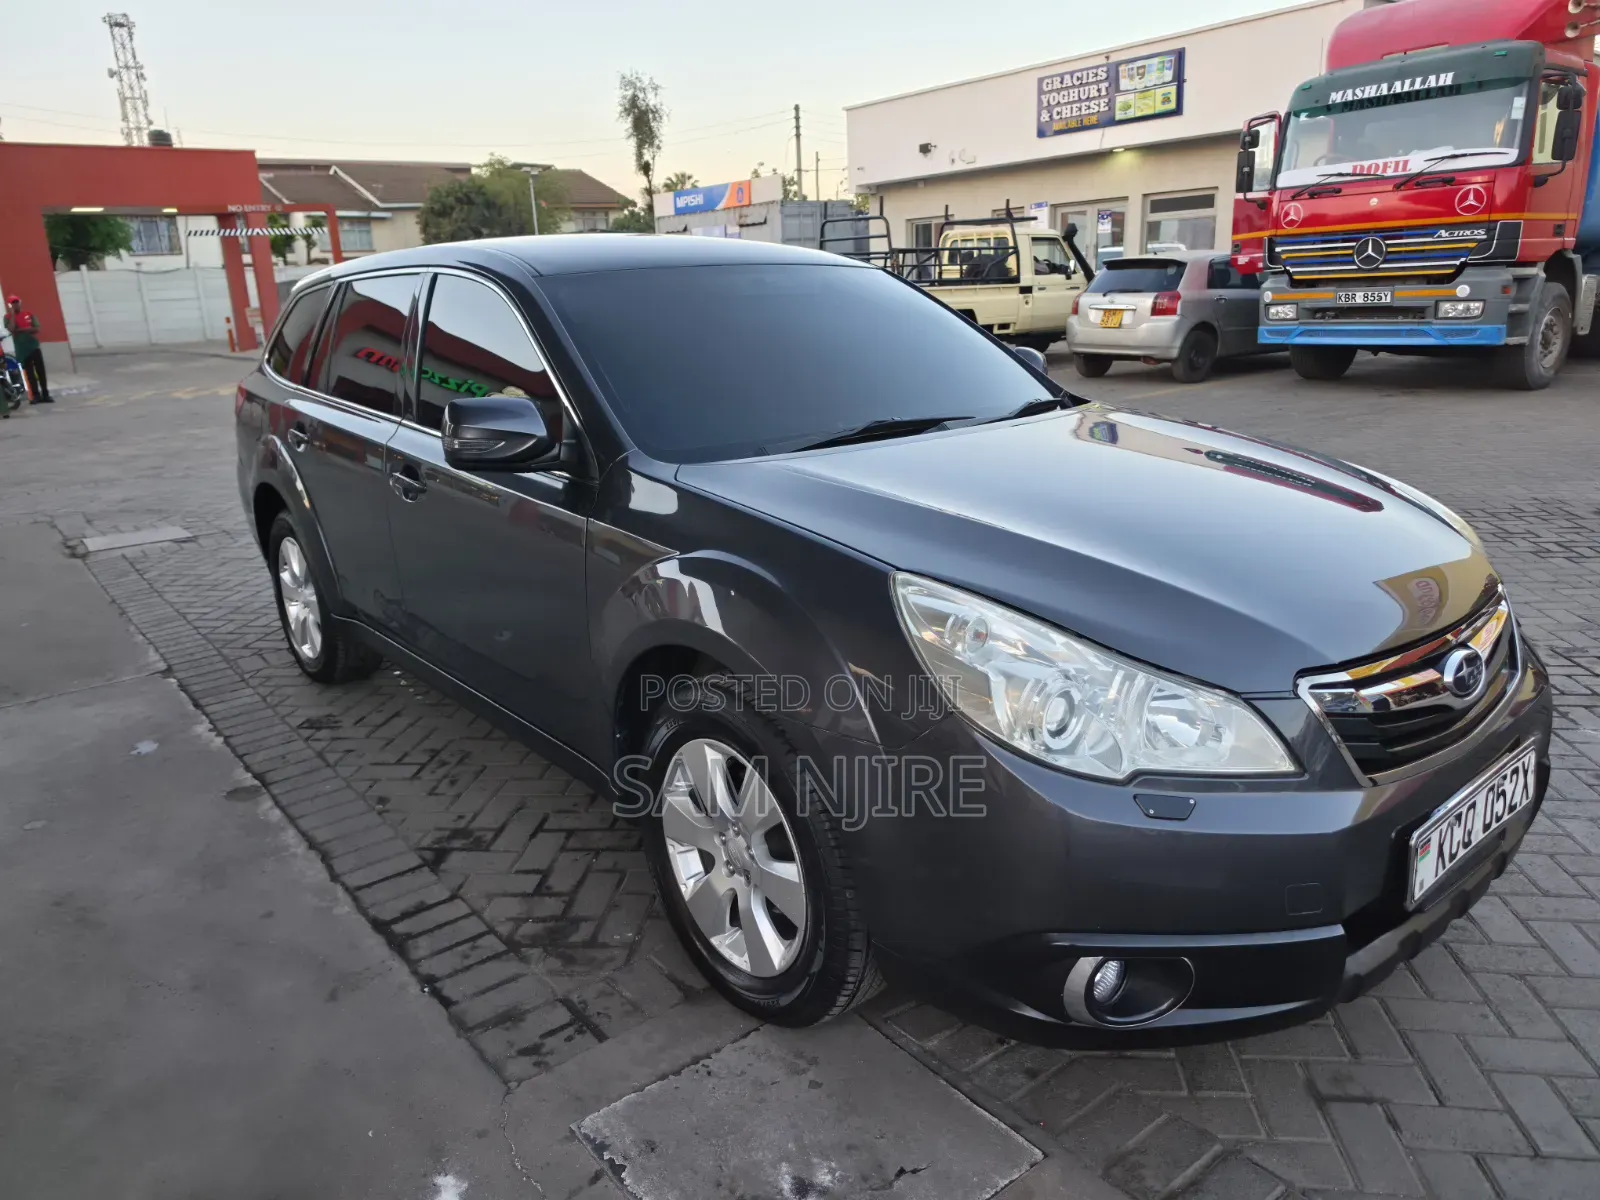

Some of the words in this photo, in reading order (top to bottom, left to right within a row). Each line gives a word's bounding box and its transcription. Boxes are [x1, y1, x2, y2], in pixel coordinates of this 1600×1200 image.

[1043, 67, 1108, 91] GRACIES
[1328, 72, 1455, 104] MASHAALLAH
[1041, 82, 1109, 107] YOGHURT
[1040, 109, 1050, 122] &
[1053, 98, 1109, 120] CHEESE
[1337, 293, 1357, 303] KBR
[1362, 292, 1389, 302] 855Y
[1435, 800, 1476, 878] KCQ
[1482, 755, 1532, 835] 052X
